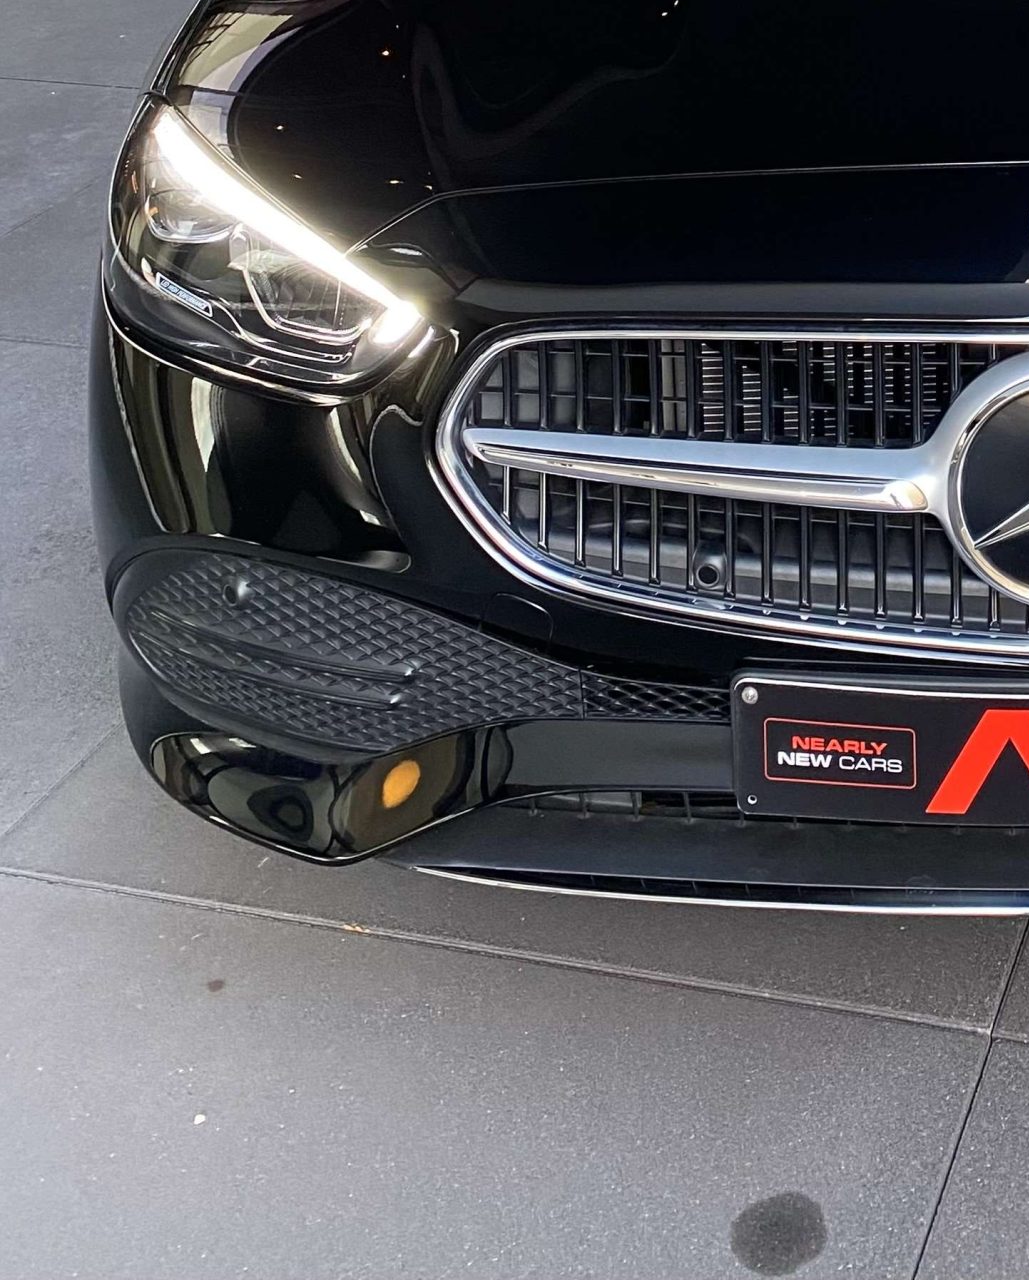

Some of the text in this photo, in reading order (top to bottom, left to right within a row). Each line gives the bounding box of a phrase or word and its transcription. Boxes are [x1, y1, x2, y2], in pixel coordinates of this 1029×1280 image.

[791, 735, 888, 755] NEARLY
[777, 751, 903, 773] NEW CARS
